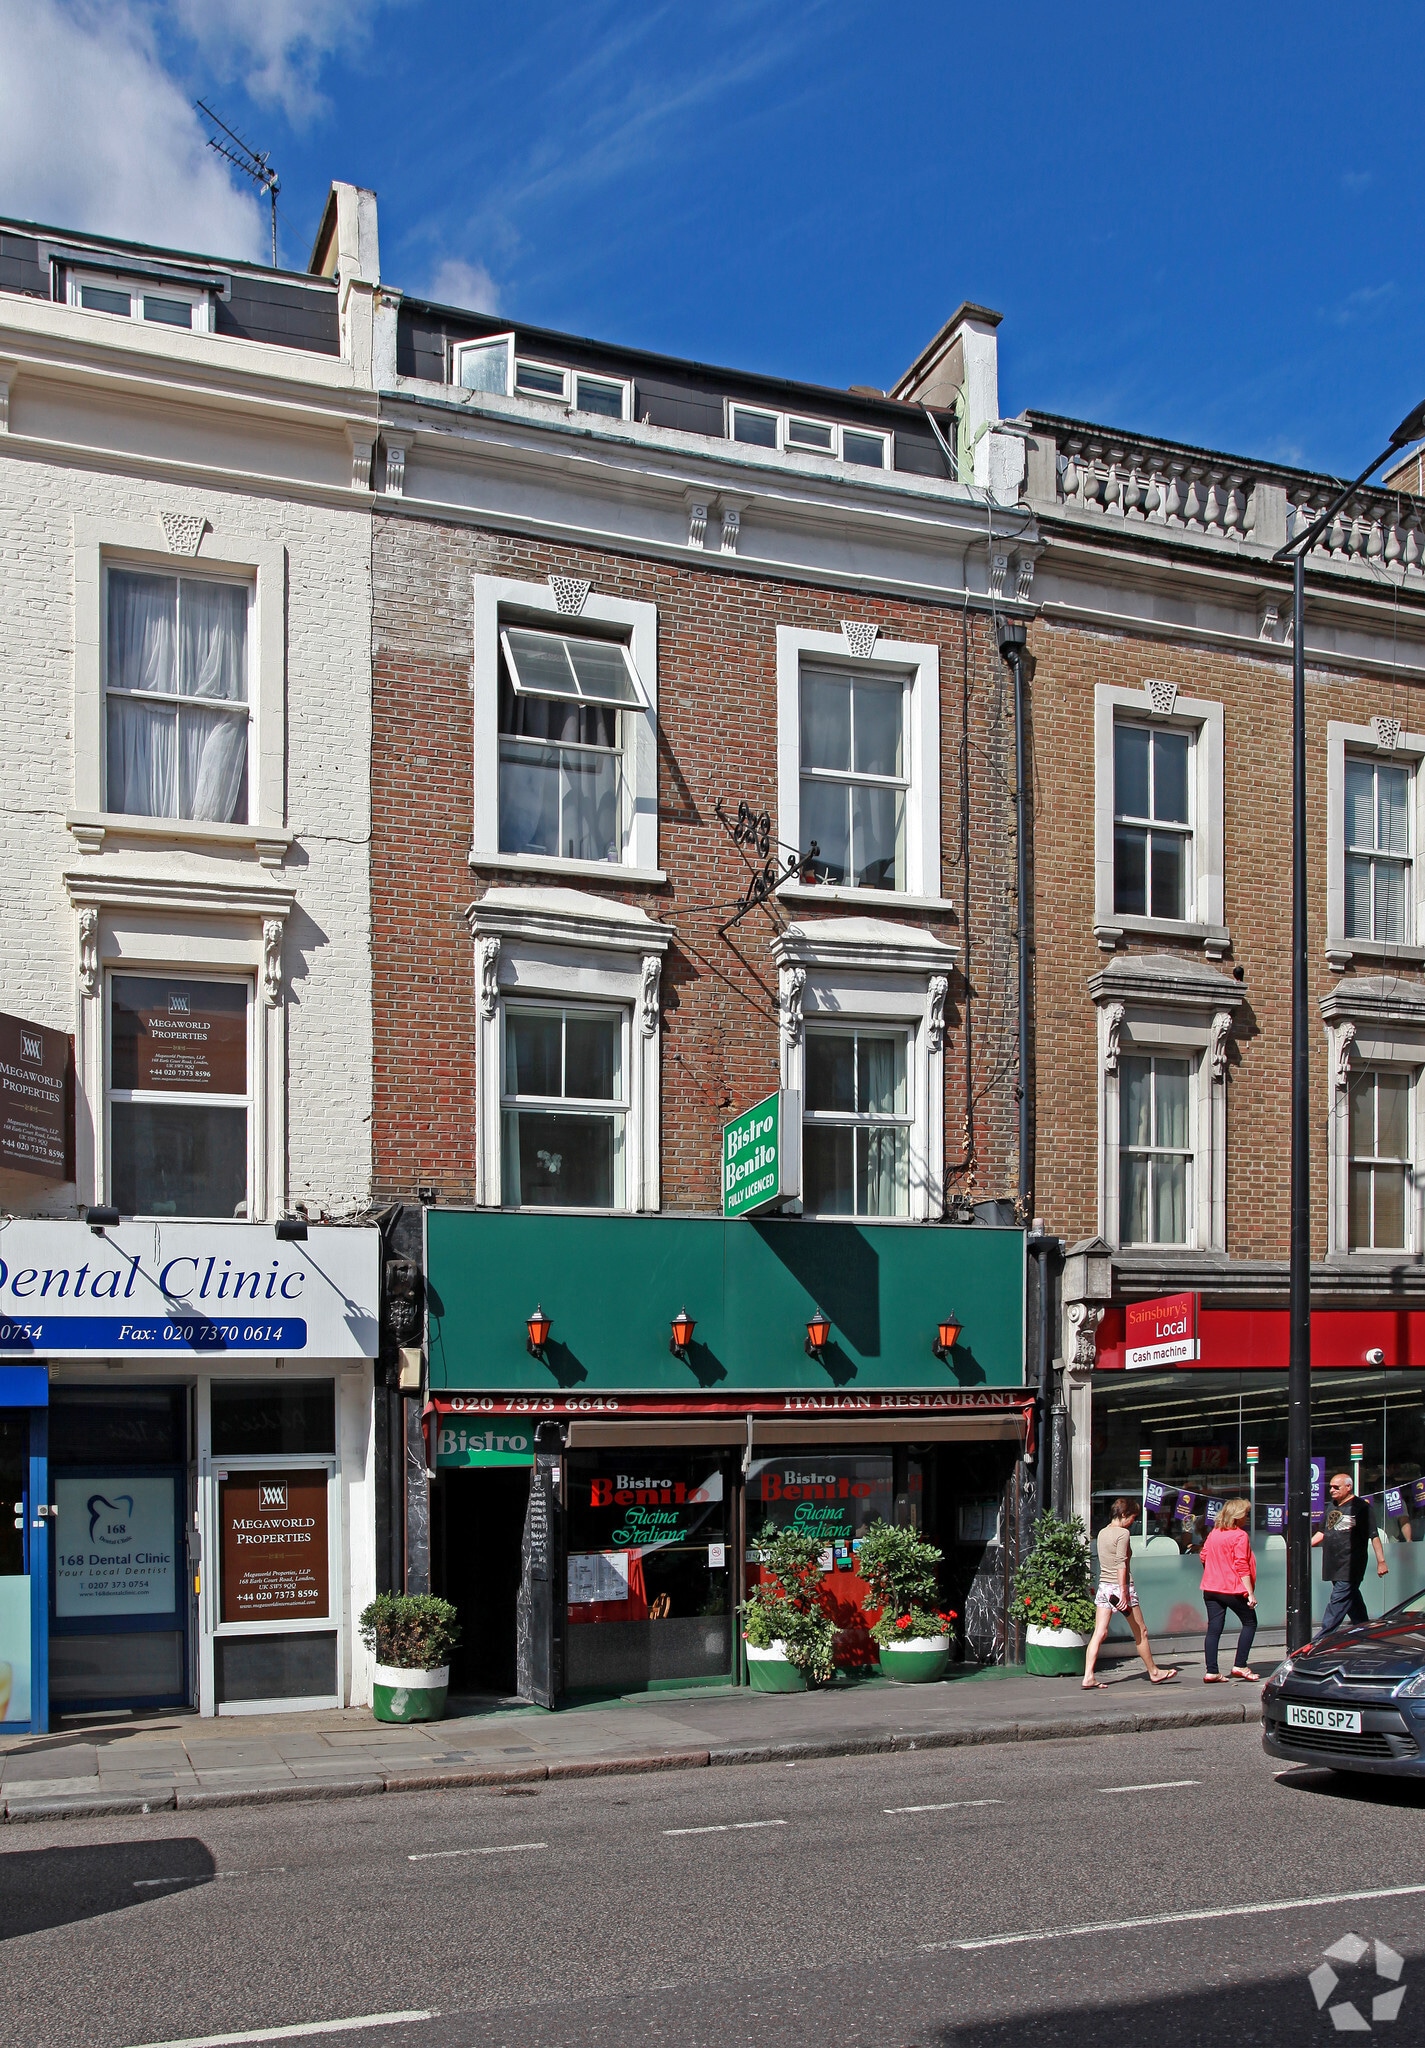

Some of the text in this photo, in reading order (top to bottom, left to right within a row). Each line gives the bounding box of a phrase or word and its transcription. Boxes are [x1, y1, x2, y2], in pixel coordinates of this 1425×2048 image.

[148, 1018, 211, 1030] MEGAWORLD
[151, 1030, 208, 1041] PROPERTIES
[0, 1062, 63, 1089] MEGAWORLD
[194, 1070, 211, 1078] 8596
[3, 1078, 60, 1103] PROPERTIES
[727, 1115, 774, 1160] Bistro
[1, 1138, 65, 1159] +44 020 7373 8596
[725, 1144, 776, 1192] Benito
[728, 1173, 775, 1209] FULLY LICENCED
[0, 1255, 306, 1299] ental Clinic
[1129, 1301, 1188, 1325] Sainsbury's
[1, 1324, 283, 1341] 0754 Fax: 020 7370 0614
[1156, 1316, 1187, 1338] Local
[1132, 1346, 1187, 1363] Cash machine
[451, 1393, 1018, 1411] 020 7373 6646 ITALIAN RESTAURANT
[437, 1429, 528, 1455] Bistro
[616, 1475, 673, 1489] Bistro
[784, 1470, 837, 1485] Bistro
[590, 1478, 710, 1507] Benito
[761, 1473, 872, 1501] Benito
[1148, 1483, 1163, 1497] 50
[1385, 1491, 1400, 1502] 50
[794, 1502, 846, 1521] Cucina
[1208, 1500, 1223, 1511] 50
[1267, 1507, 1283, 1518] 50
[232, 1517, 316, 1530] MEGAWORLD
[625, 1505, 680, 1525] Cucina
[107, 1524, 126, 1534] 168
[611, 1525, 688, 1545] Italiana
[236, 1532, 312, 1545] PROPERTIES
[58, 1553, 171, 1566] 168 Dental Clinic
[58, 1567, 167, 1577] Your Local Dentist
[112, 1581, 126, 1589] 373
[236, 1589, 319, 1601] +44 020 7373 8596
[1292, 1708, 1354, 1729] HS60 SPZ
